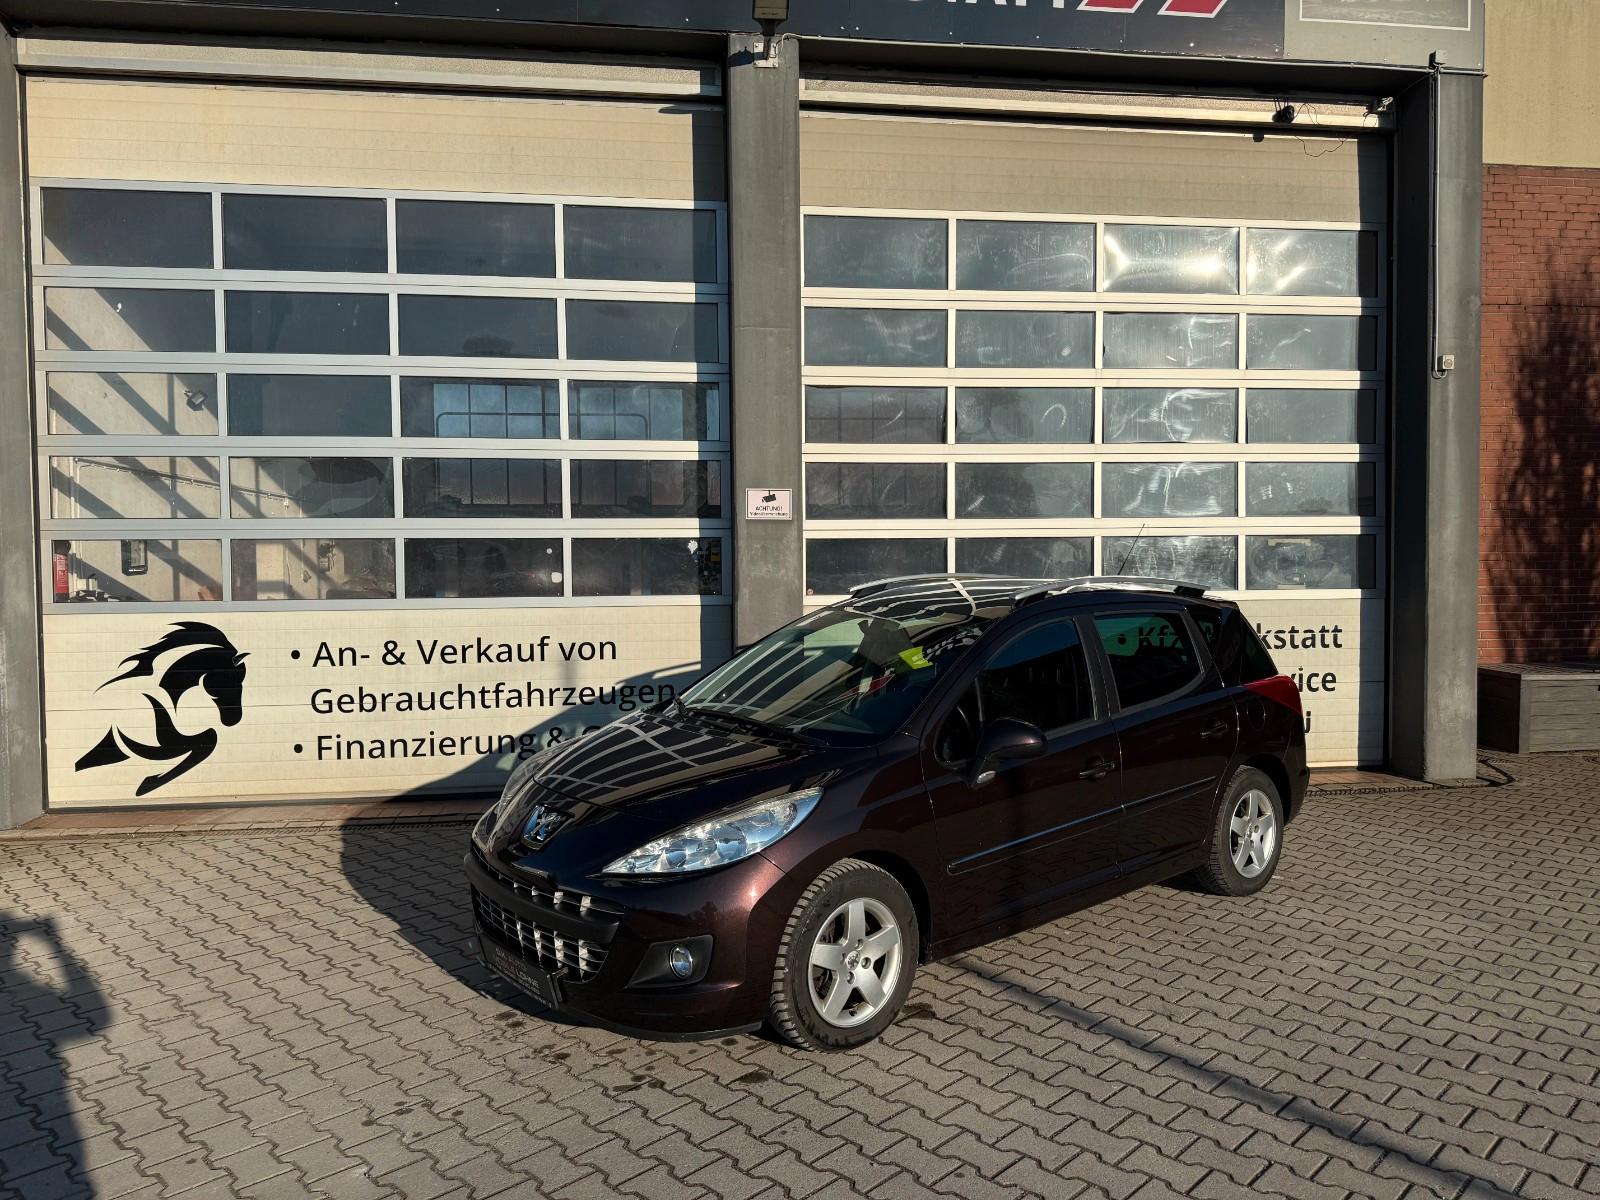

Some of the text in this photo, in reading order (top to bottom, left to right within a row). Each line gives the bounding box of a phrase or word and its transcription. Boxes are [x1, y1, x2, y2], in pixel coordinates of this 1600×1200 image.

[1256, 622, 1343, 650] kstatt
[312, 636, 617, 668] An- & Verkauf von
[310, 682, 676, 714] Gebrauchtfahrzeugen
[316, 731, 537, 761] Finanzierung
